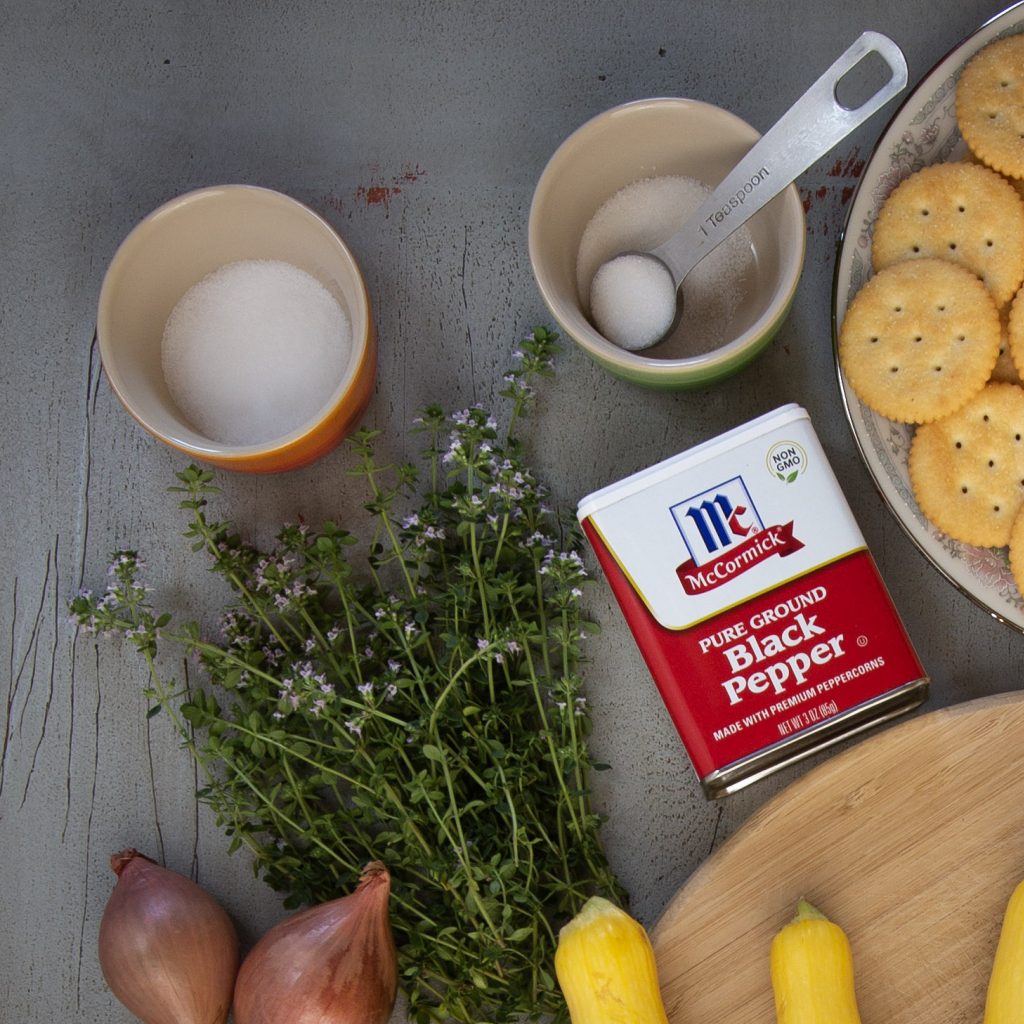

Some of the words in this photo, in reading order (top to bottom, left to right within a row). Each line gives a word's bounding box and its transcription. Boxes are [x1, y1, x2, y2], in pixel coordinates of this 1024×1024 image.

[705, 167, 770, 227] Teaspoon
[772, 447, 796, 463] NON
[777, 456, 800, 471] GMO
[684, 531, 786, 590] McCormick
[698, 622, 748, 654] PURE
[749, 586, 827, 629] GROUND
[722, 613, 826, 674] Black
[712, 723, 743, 742] MADE
[742, 708, 770, 728] WITH
[770, 688, 817, 715] PREMIUM
[816, 656, 885, 694] PEPPERCORNS
[721, 634, 845, 706] Pepper
[777, 720, 792, 736] NET
[790, 715, 803, 729] WT
[802, 712, 810, 724] 3
[808, 708, 820, 722] OZ
[819, 700, 839, 718] (85g)
